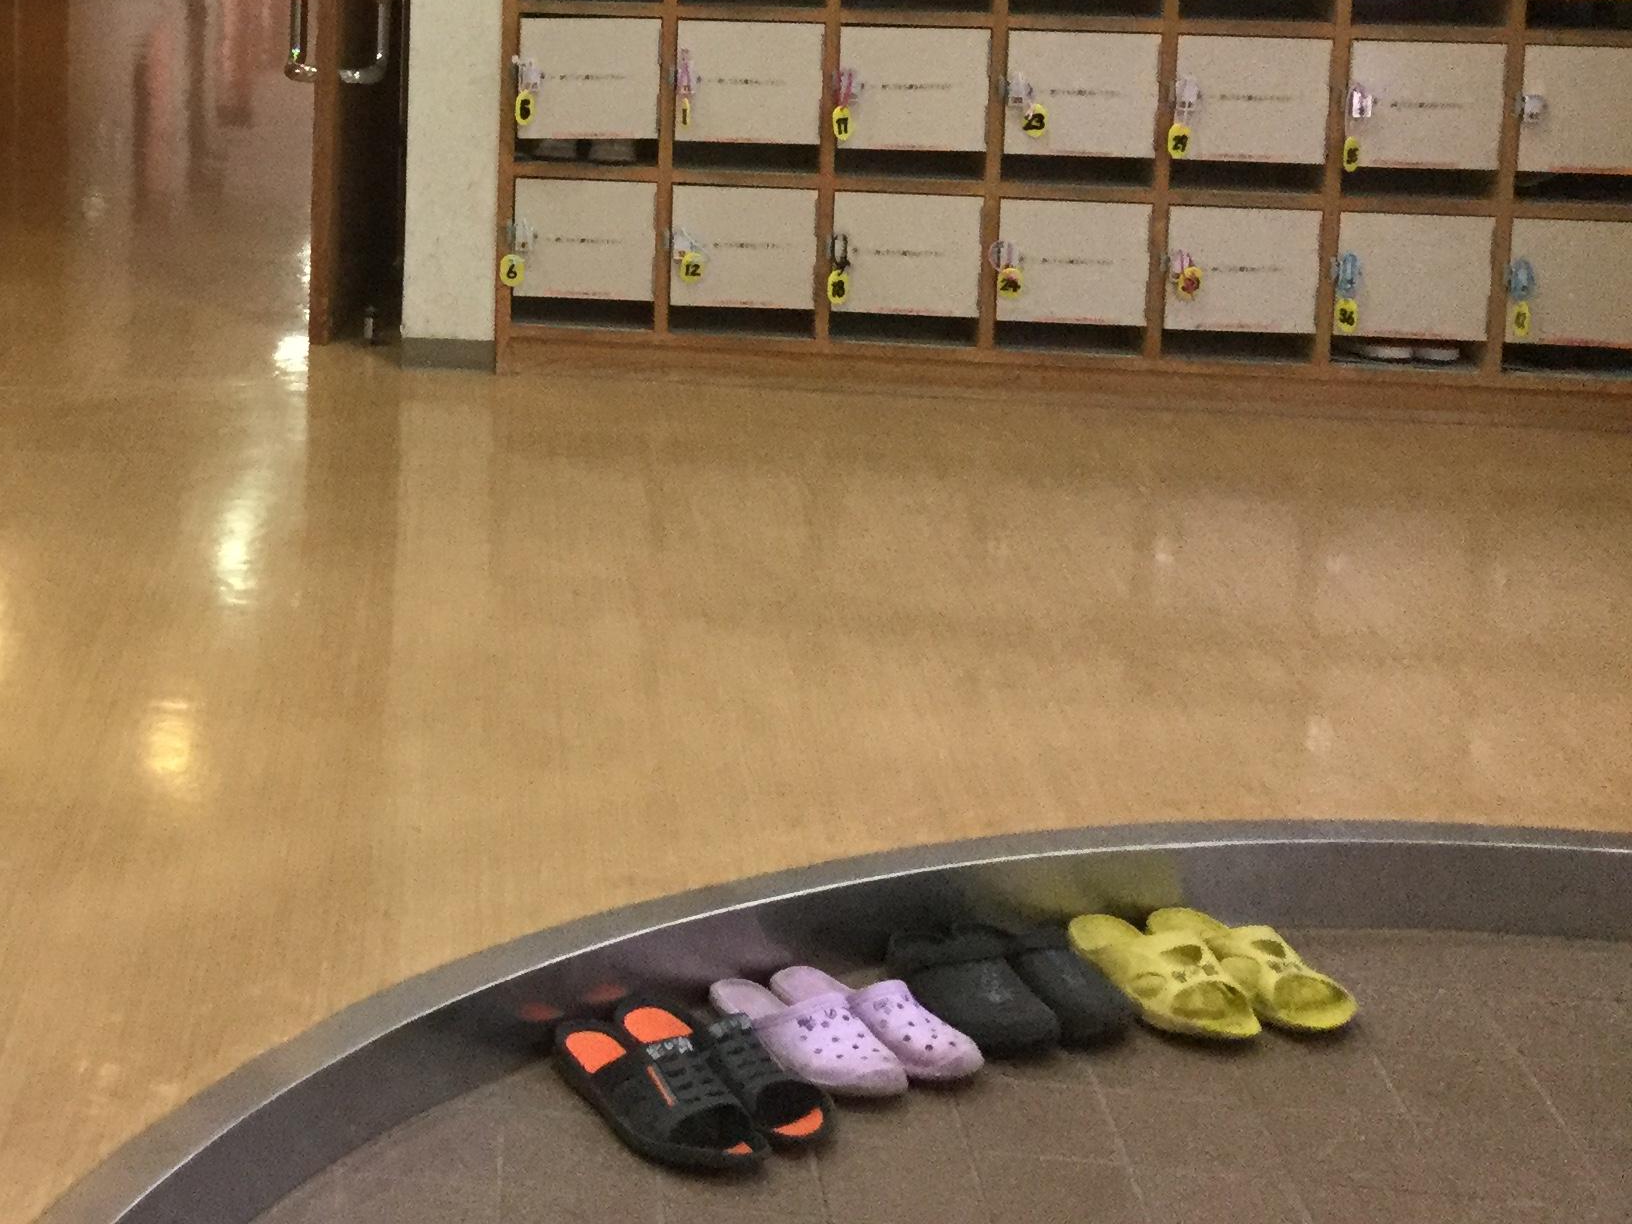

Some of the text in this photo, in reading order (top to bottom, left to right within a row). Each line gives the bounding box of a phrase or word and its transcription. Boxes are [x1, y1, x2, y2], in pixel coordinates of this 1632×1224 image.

[1023, 112, 1046, 131] 23
[506, 264, 518, 280] 6
[685, 263, 701, 277] 12
